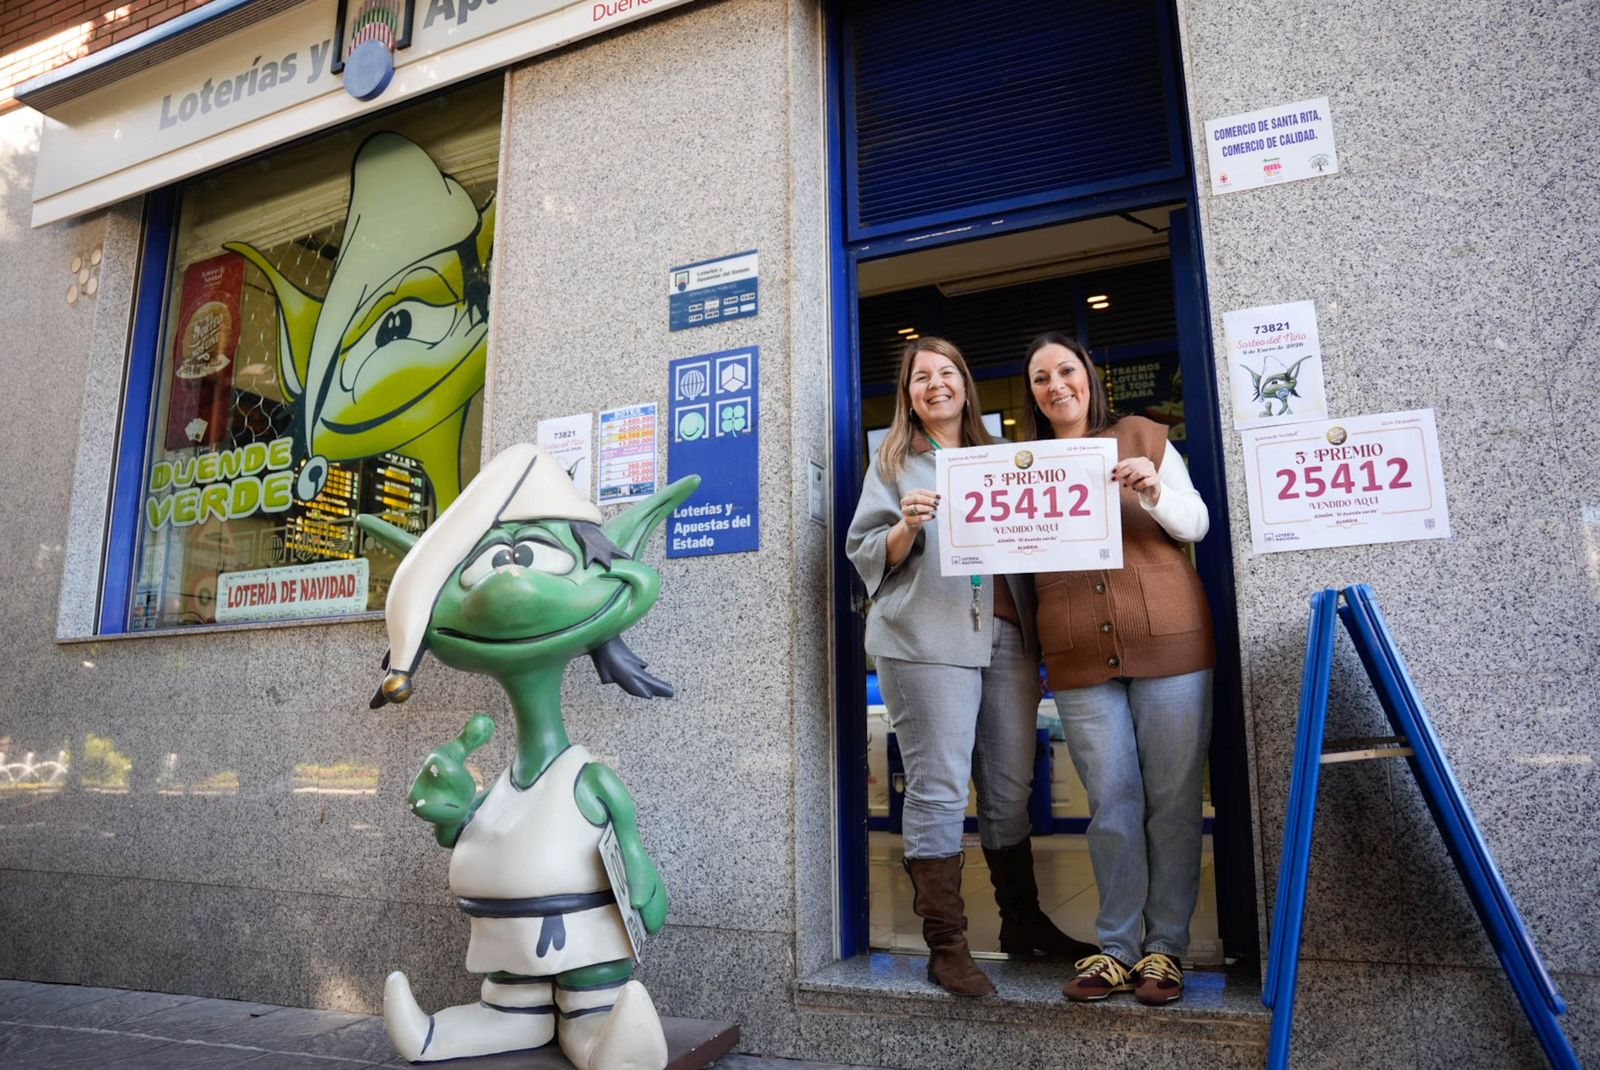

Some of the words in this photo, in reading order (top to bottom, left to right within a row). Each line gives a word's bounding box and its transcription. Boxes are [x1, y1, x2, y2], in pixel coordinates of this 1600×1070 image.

[159, 51, 298, 131] Loterías
[306, 38, 331, 84] y
[1214, 122, 1256, 141] COMERCIO
[1258, 119, 1269, 132] DE
[1271, 113, 1299, 130] SANTA
[1222, 138, 1265, 157] COMERCIO
[1266, 136, 1278, 149] DE
[1280, 129, 1318, 146] CALIDAD.
[1253, 321, 1290, 335] 73821
[1237, 338, 1265, 349] Sorteo
[1266, 334, 1282, 345] del
[1314, 443, 1383, 462] PREMIO
[149, 437, 293, 492] DUENDE
[1001, 468, 1066, 487] PREMIO
[1275, 457, 1412, 500] 25412
[146, 470, 294, 532] VERDE
[673, 502, 722, 518] Loterías
[725, 503, 733, 516] y
[964, 483, 1091, 523] 25412
[1309, 499, 1352, 510] VENDIDO
[673, 518, 730, 536] Apuestas
[731, 514, 751, 528] del
[993, 524, 1033, 535] VENDIDO
[672, 534, 715, 550] Estado
[227, 577, 277, 609] LOTERÍA
[281, 579, 297, 603] DE
[300, 574, 356, 602] NAVIDAD
